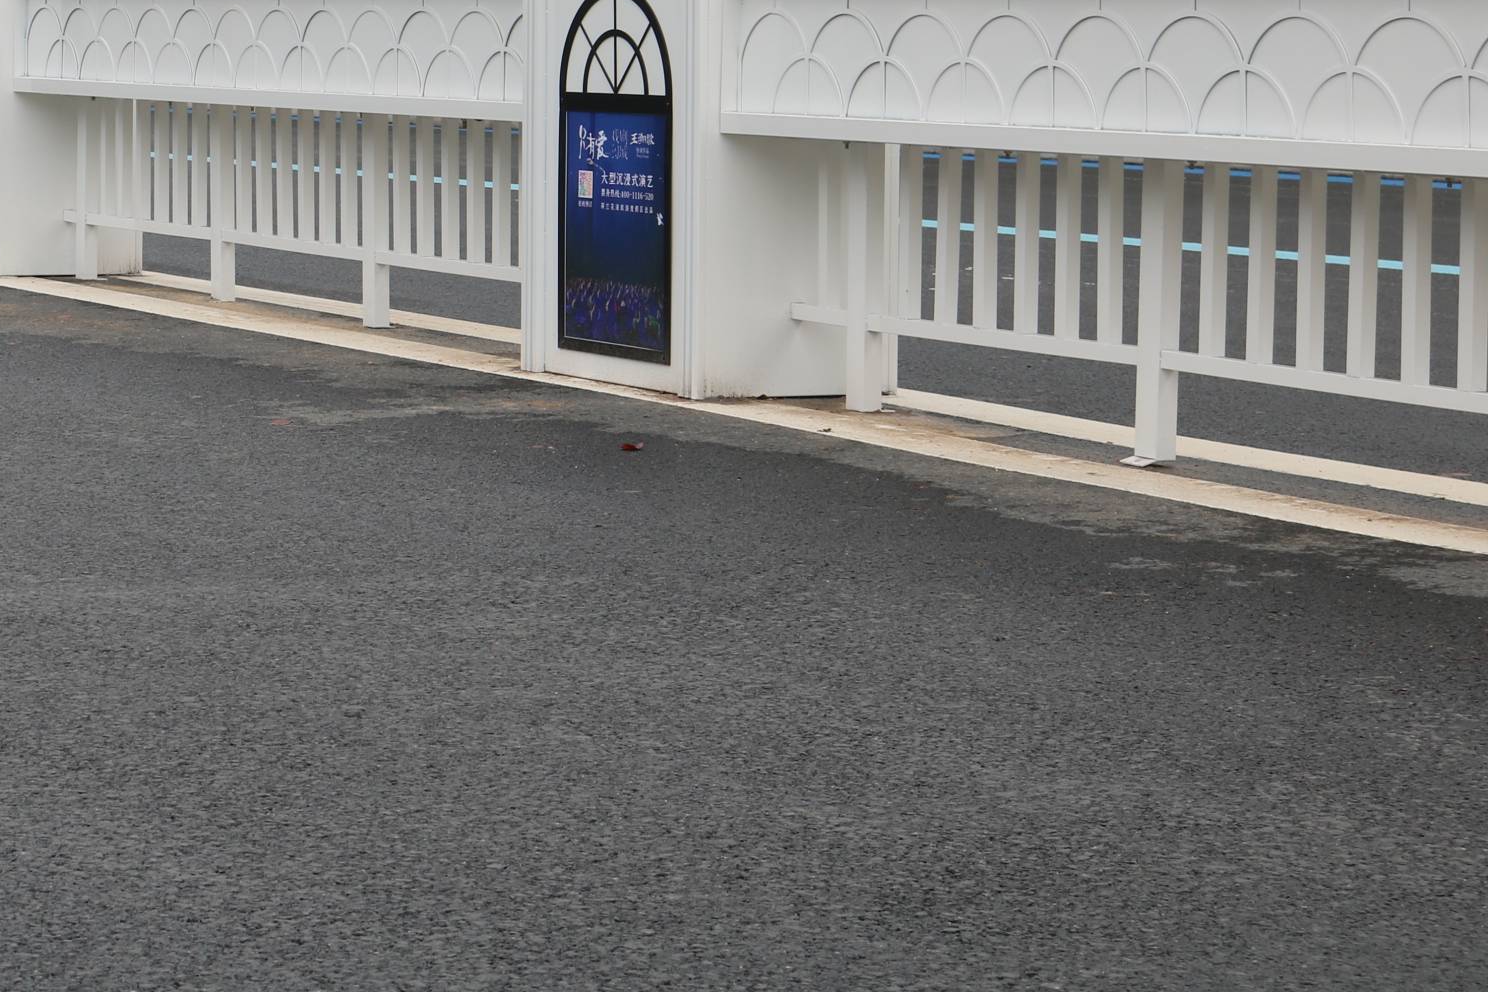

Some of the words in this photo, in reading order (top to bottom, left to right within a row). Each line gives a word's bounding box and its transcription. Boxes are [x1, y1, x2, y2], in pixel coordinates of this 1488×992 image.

[601, 172, 654, 188] 大型沉浸式演艺
